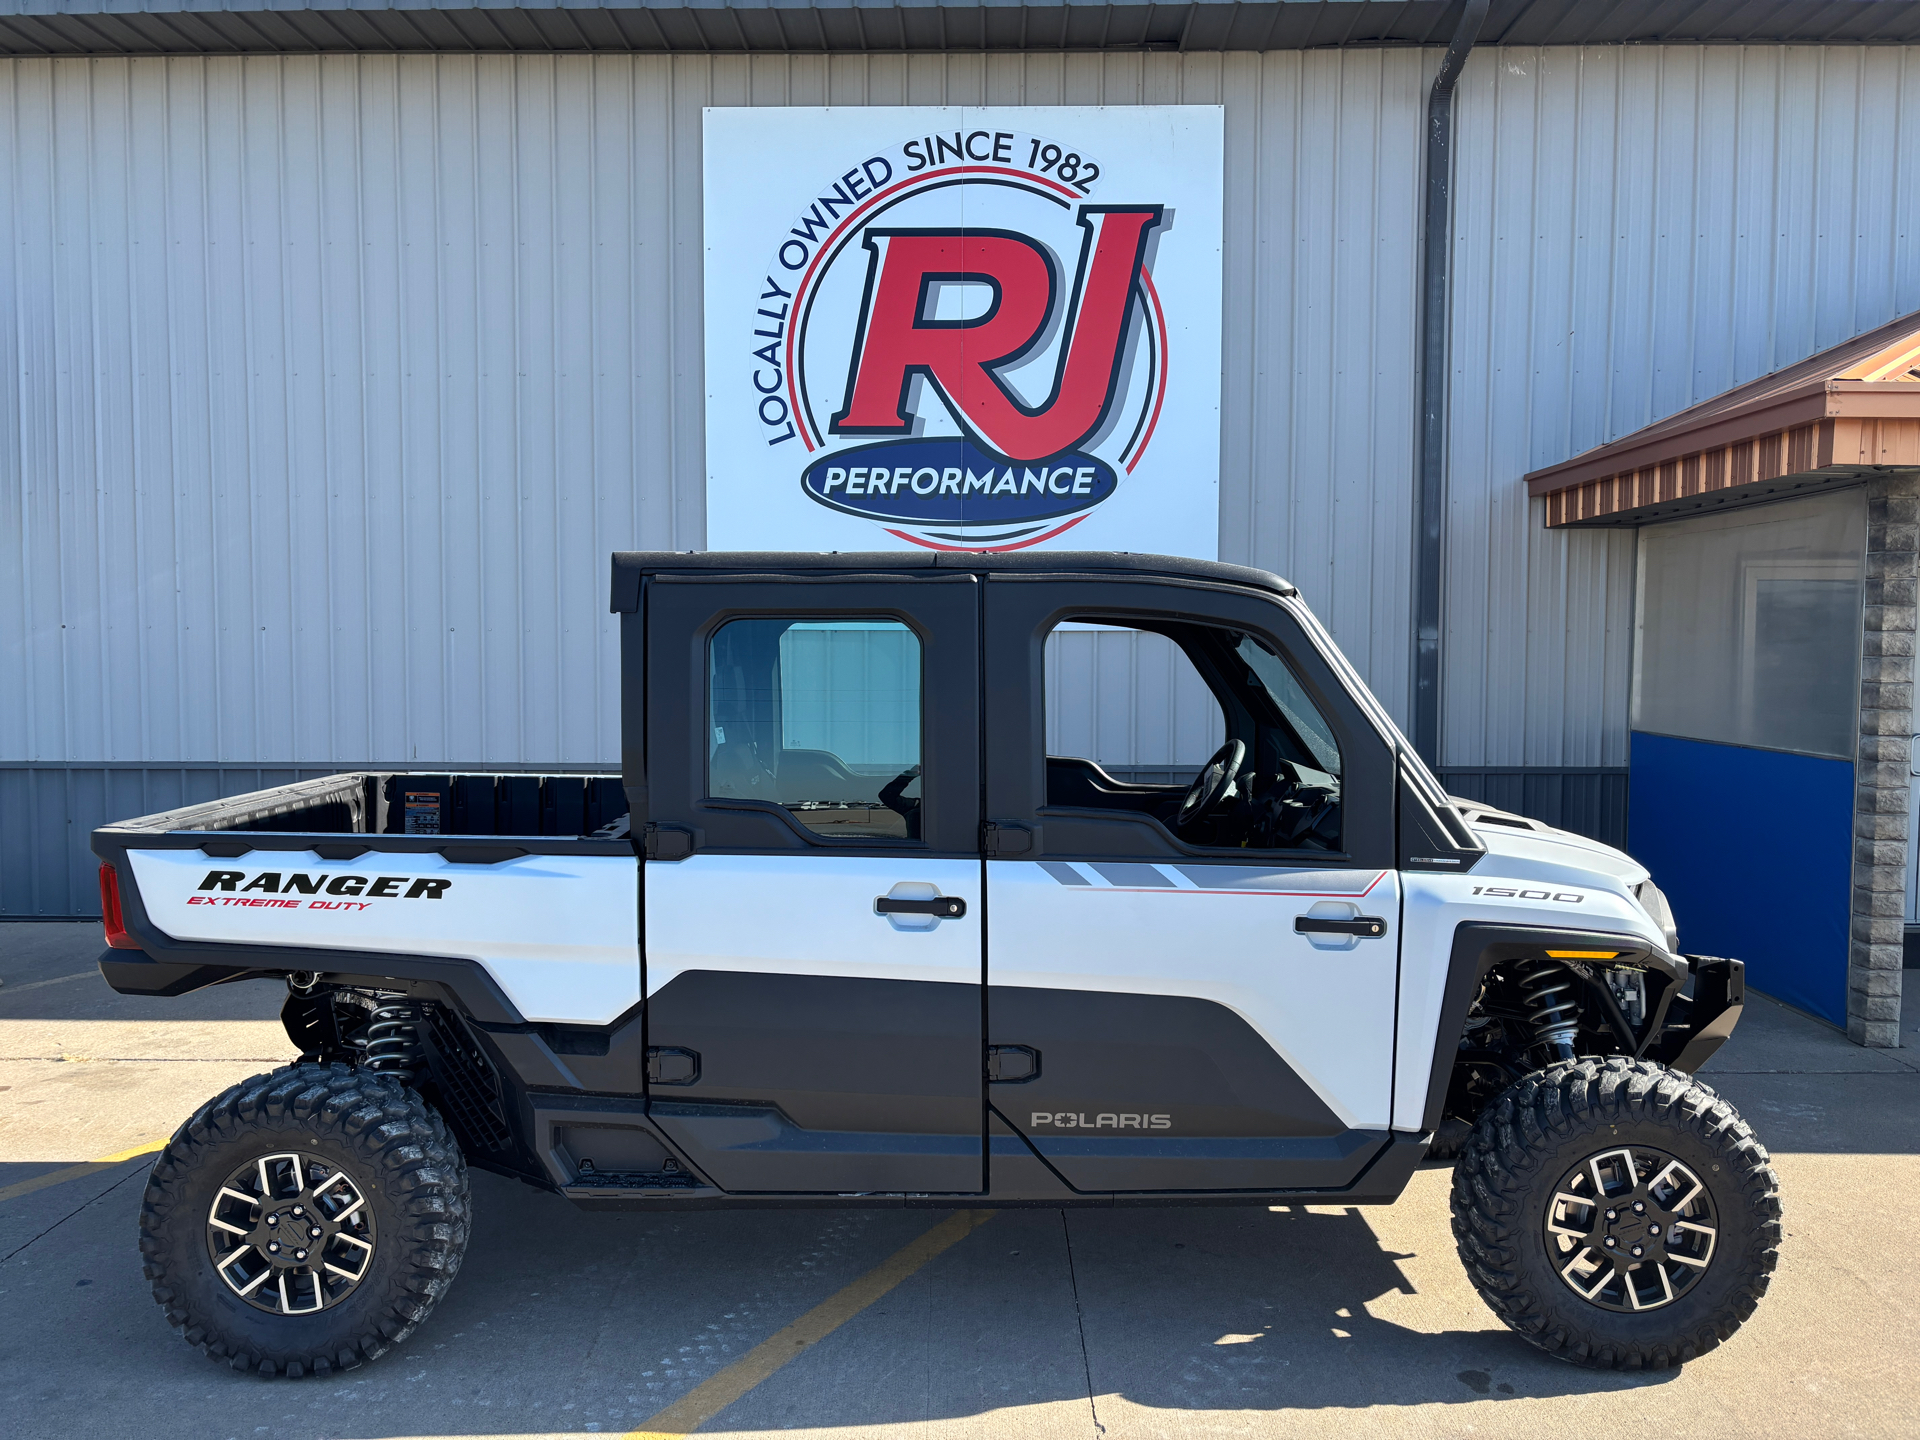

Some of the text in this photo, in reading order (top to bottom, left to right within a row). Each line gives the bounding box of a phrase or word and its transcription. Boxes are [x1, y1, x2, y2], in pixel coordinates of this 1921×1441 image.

[752, 131, 1100, 446] LOCALLY OWNED SINCE 1982
[828, 204, 1165, 467] RJ
[822, 466, 1096, 496] PERFORMANCE
[197, 870, 452, 900] RANGER
[1472, 886, 1584, 903] 1500
[186, 896, 372, 911] EXTREME DUTY
[1031, 1112, 1172, 1129] POLARIS
